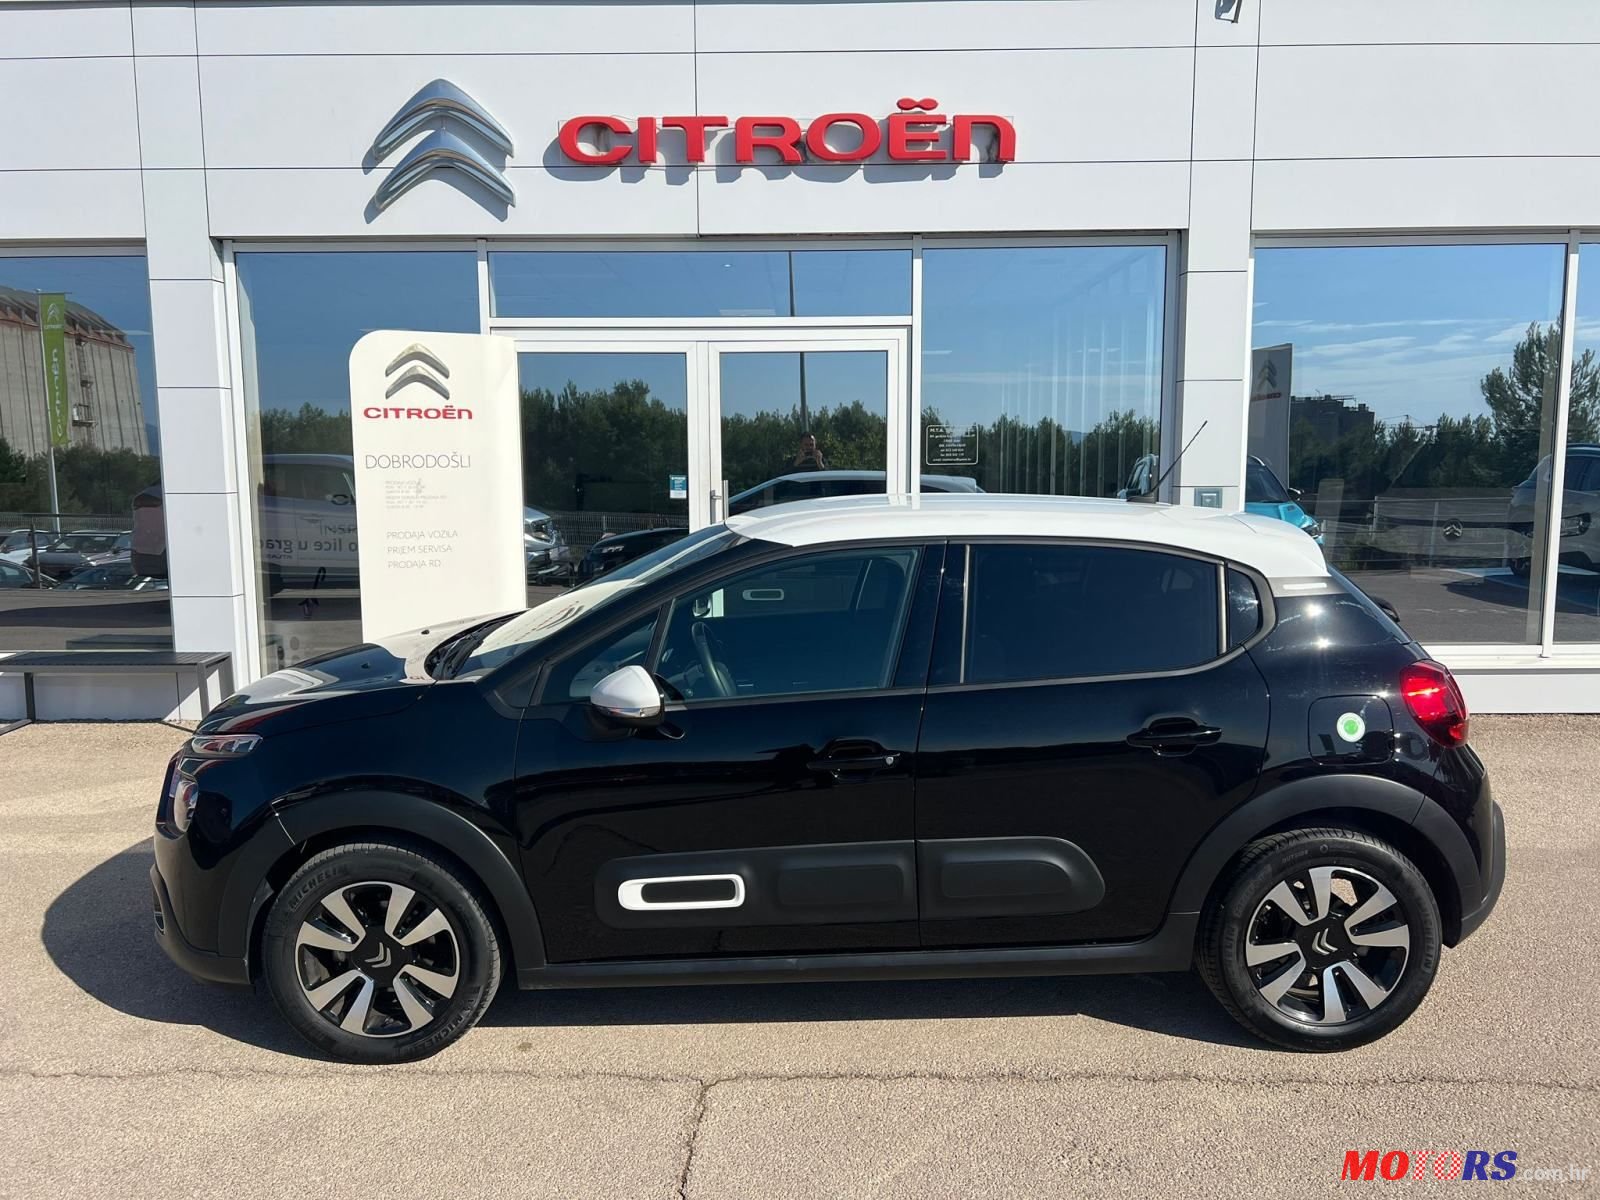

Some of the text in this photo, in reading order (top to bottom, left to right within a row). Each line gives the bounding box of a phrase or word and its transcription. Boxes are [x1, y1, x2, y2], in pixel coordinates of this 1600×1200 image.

[558, 97, 1016, 165] CITROËN
[365, 451, 471, 469] DOBRODOŠLI
[386, 529, 458, 541] PRODAJA VOZILA
[387, 543, 453, 555] PRIJEM SERVISA
[387, 559, 442, 569] PRODAJA RD
